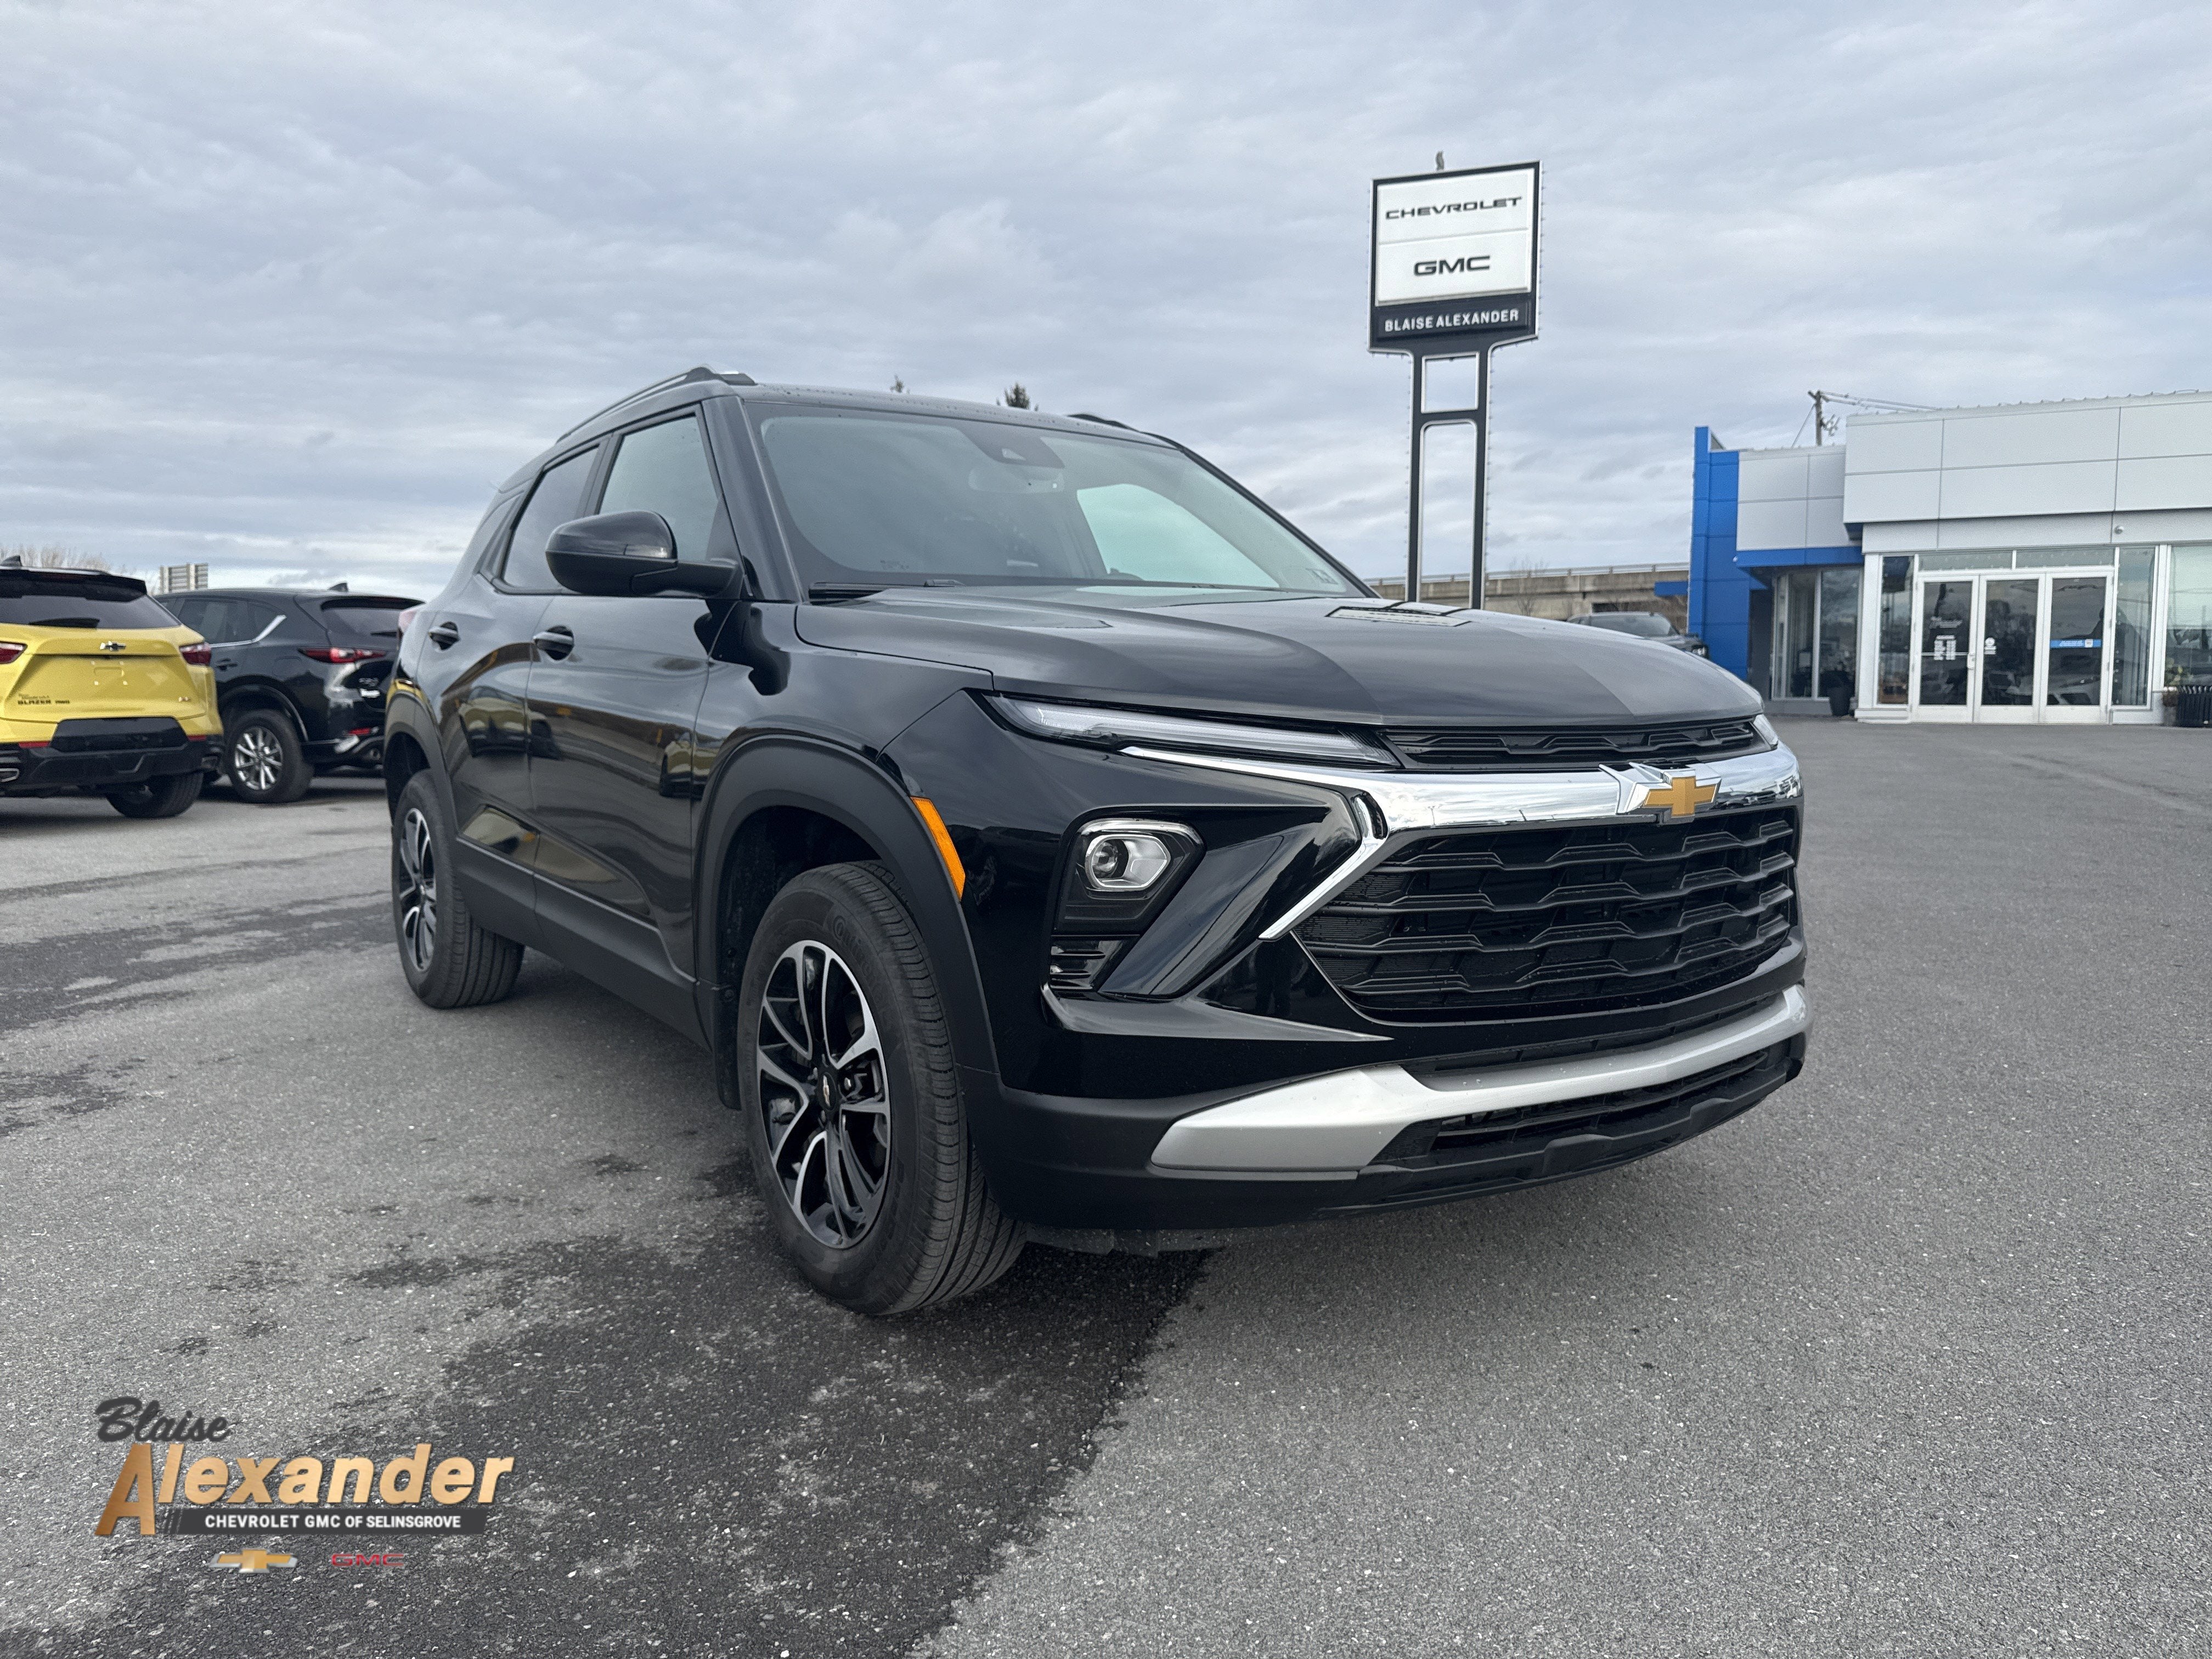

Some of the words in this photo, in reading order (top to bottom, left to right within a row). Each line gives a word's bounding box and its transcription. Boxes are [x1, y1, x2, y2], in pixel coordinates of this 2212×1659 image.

[1386, 196, 1522, 220] CHEVROLET
[1414, 255, 1490, 276] GMC
[1385, 315, 1434, 332] BLAISE
[1436, 308, 1519, 328] ALEXANDER
